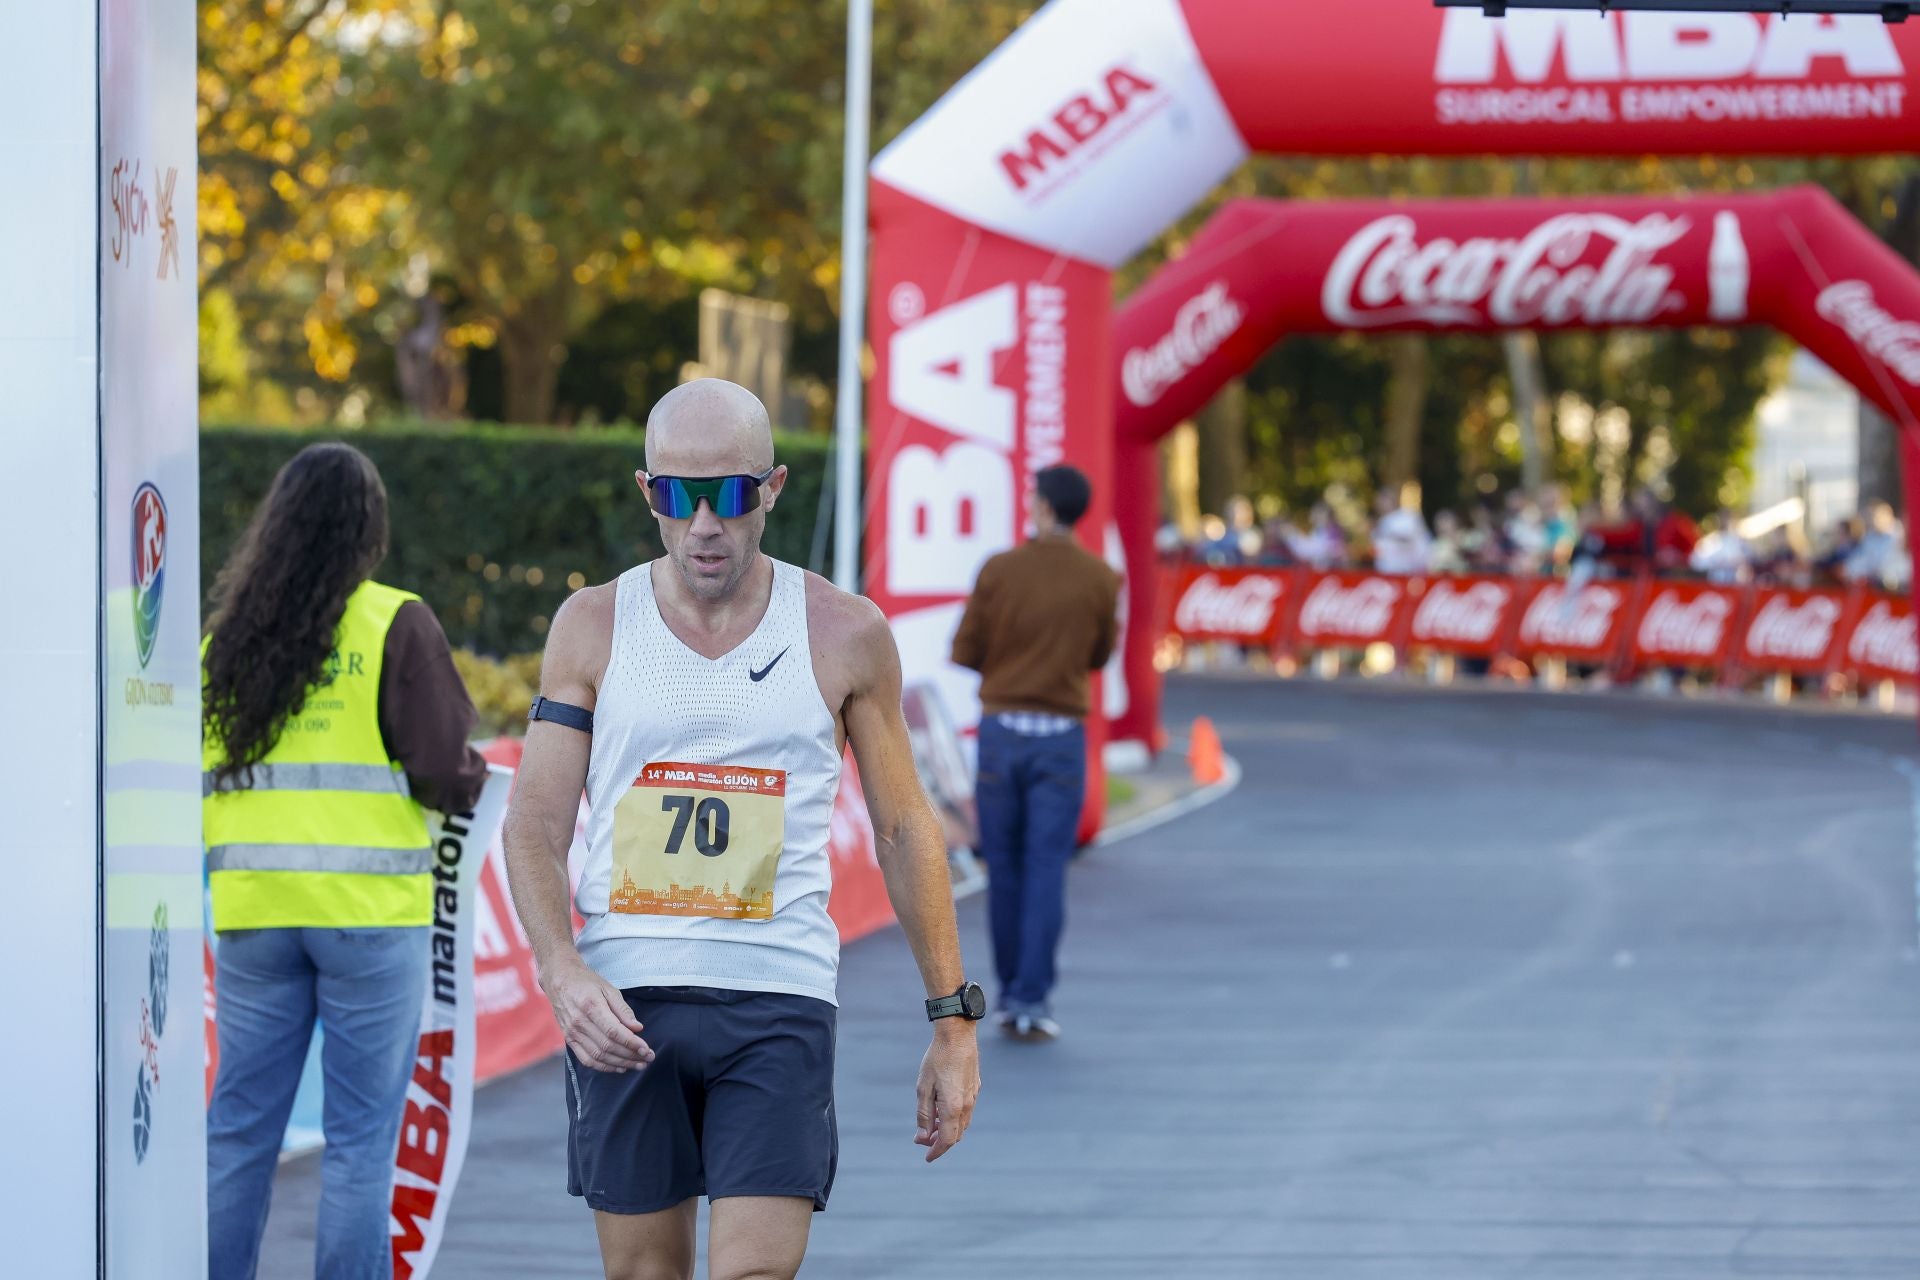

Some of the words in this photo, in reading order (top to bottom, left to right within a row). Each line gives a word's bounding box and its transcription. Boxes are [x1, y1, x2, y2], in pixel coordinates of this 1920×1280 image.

[1432, 9, 1906, 82] MBA
[1001, 68, 1155, 191] MBA
[1435, 87, 1614, 123] SURGICAL
[1619, 83, 1905, 121] EMPOWERMENT
[111, 157, 150, 269] gijón
[1321, 212, 1693, 326] Coca-Cola
[1122, 284, 1242, 405] Coca-Cola
[661, 794, 731, 857] 70
[664, 770, 696, 782] MBA
[723, 774, 758, 787] GIJÓN
[391, 1031, 455, 1280] MBA
